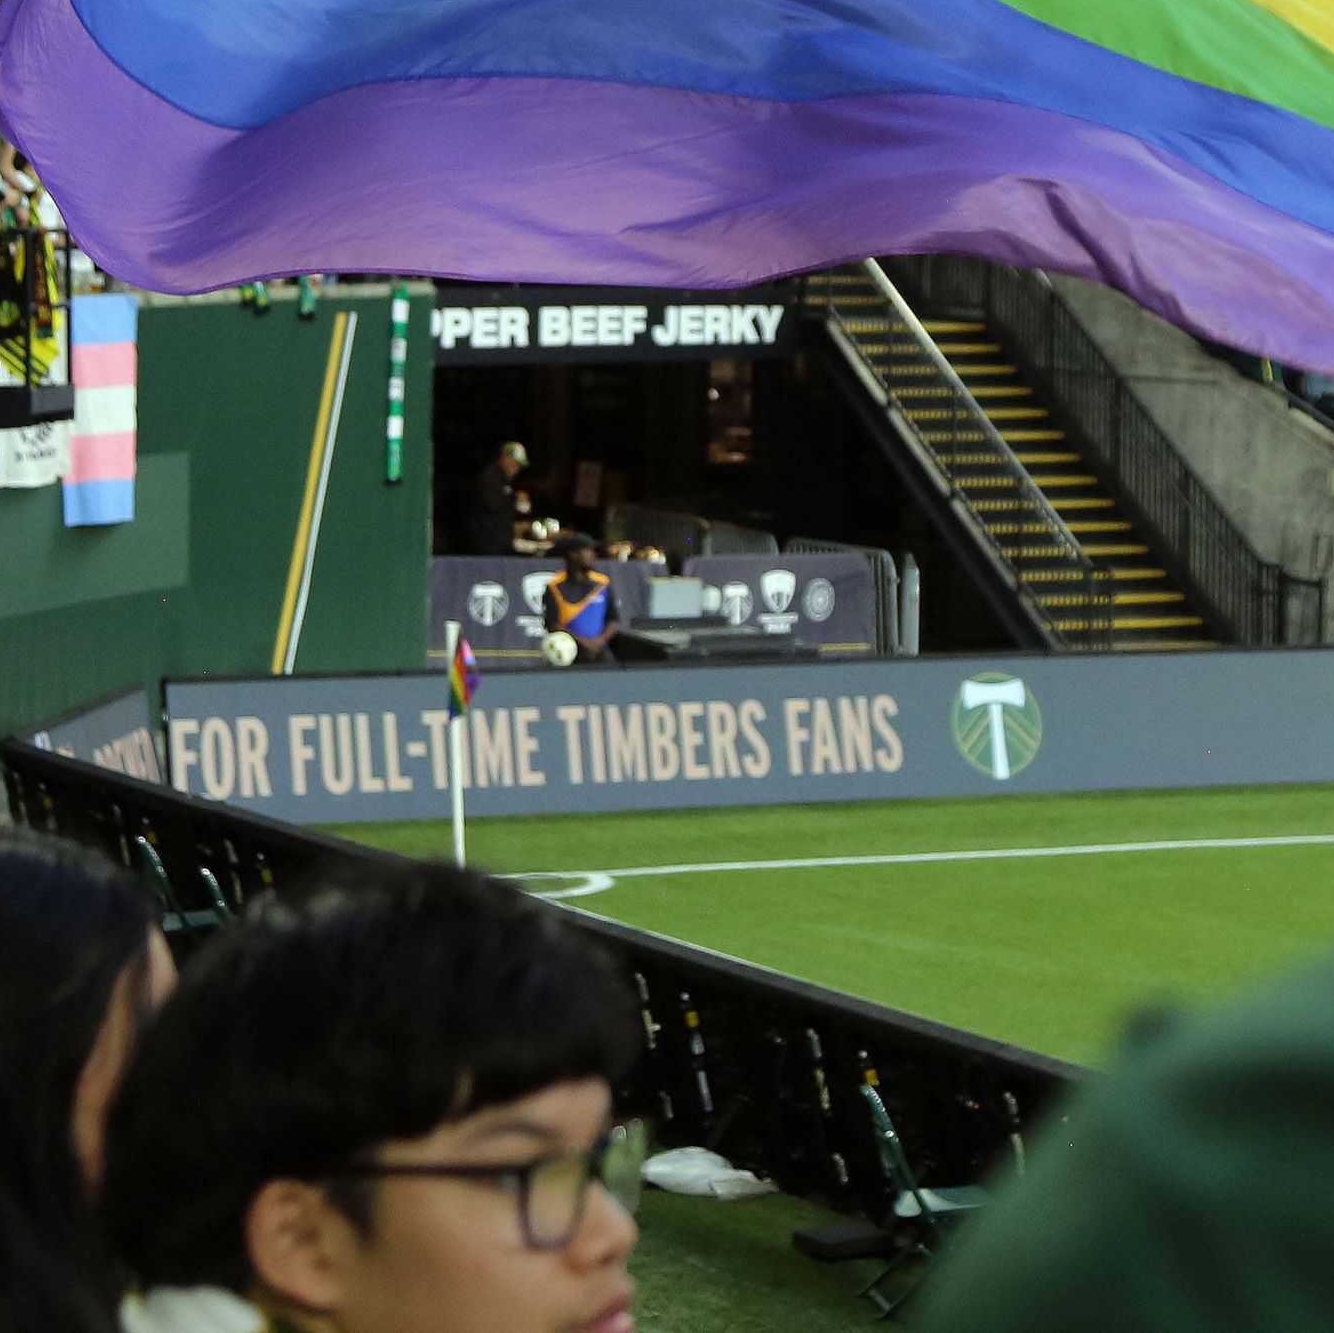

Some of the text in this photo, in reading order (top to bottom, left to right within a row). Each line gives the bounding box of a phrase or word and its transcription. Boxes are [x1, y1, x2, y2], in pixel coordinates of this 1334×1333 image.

[539, 305, 648, 349] BEEF
[653, 304, 784, 349] JERKY
[169, 716, 273, 800] FOR
[556, 698, 772, 785] TIMBERS
[783, 694, 904, 777] FANS
